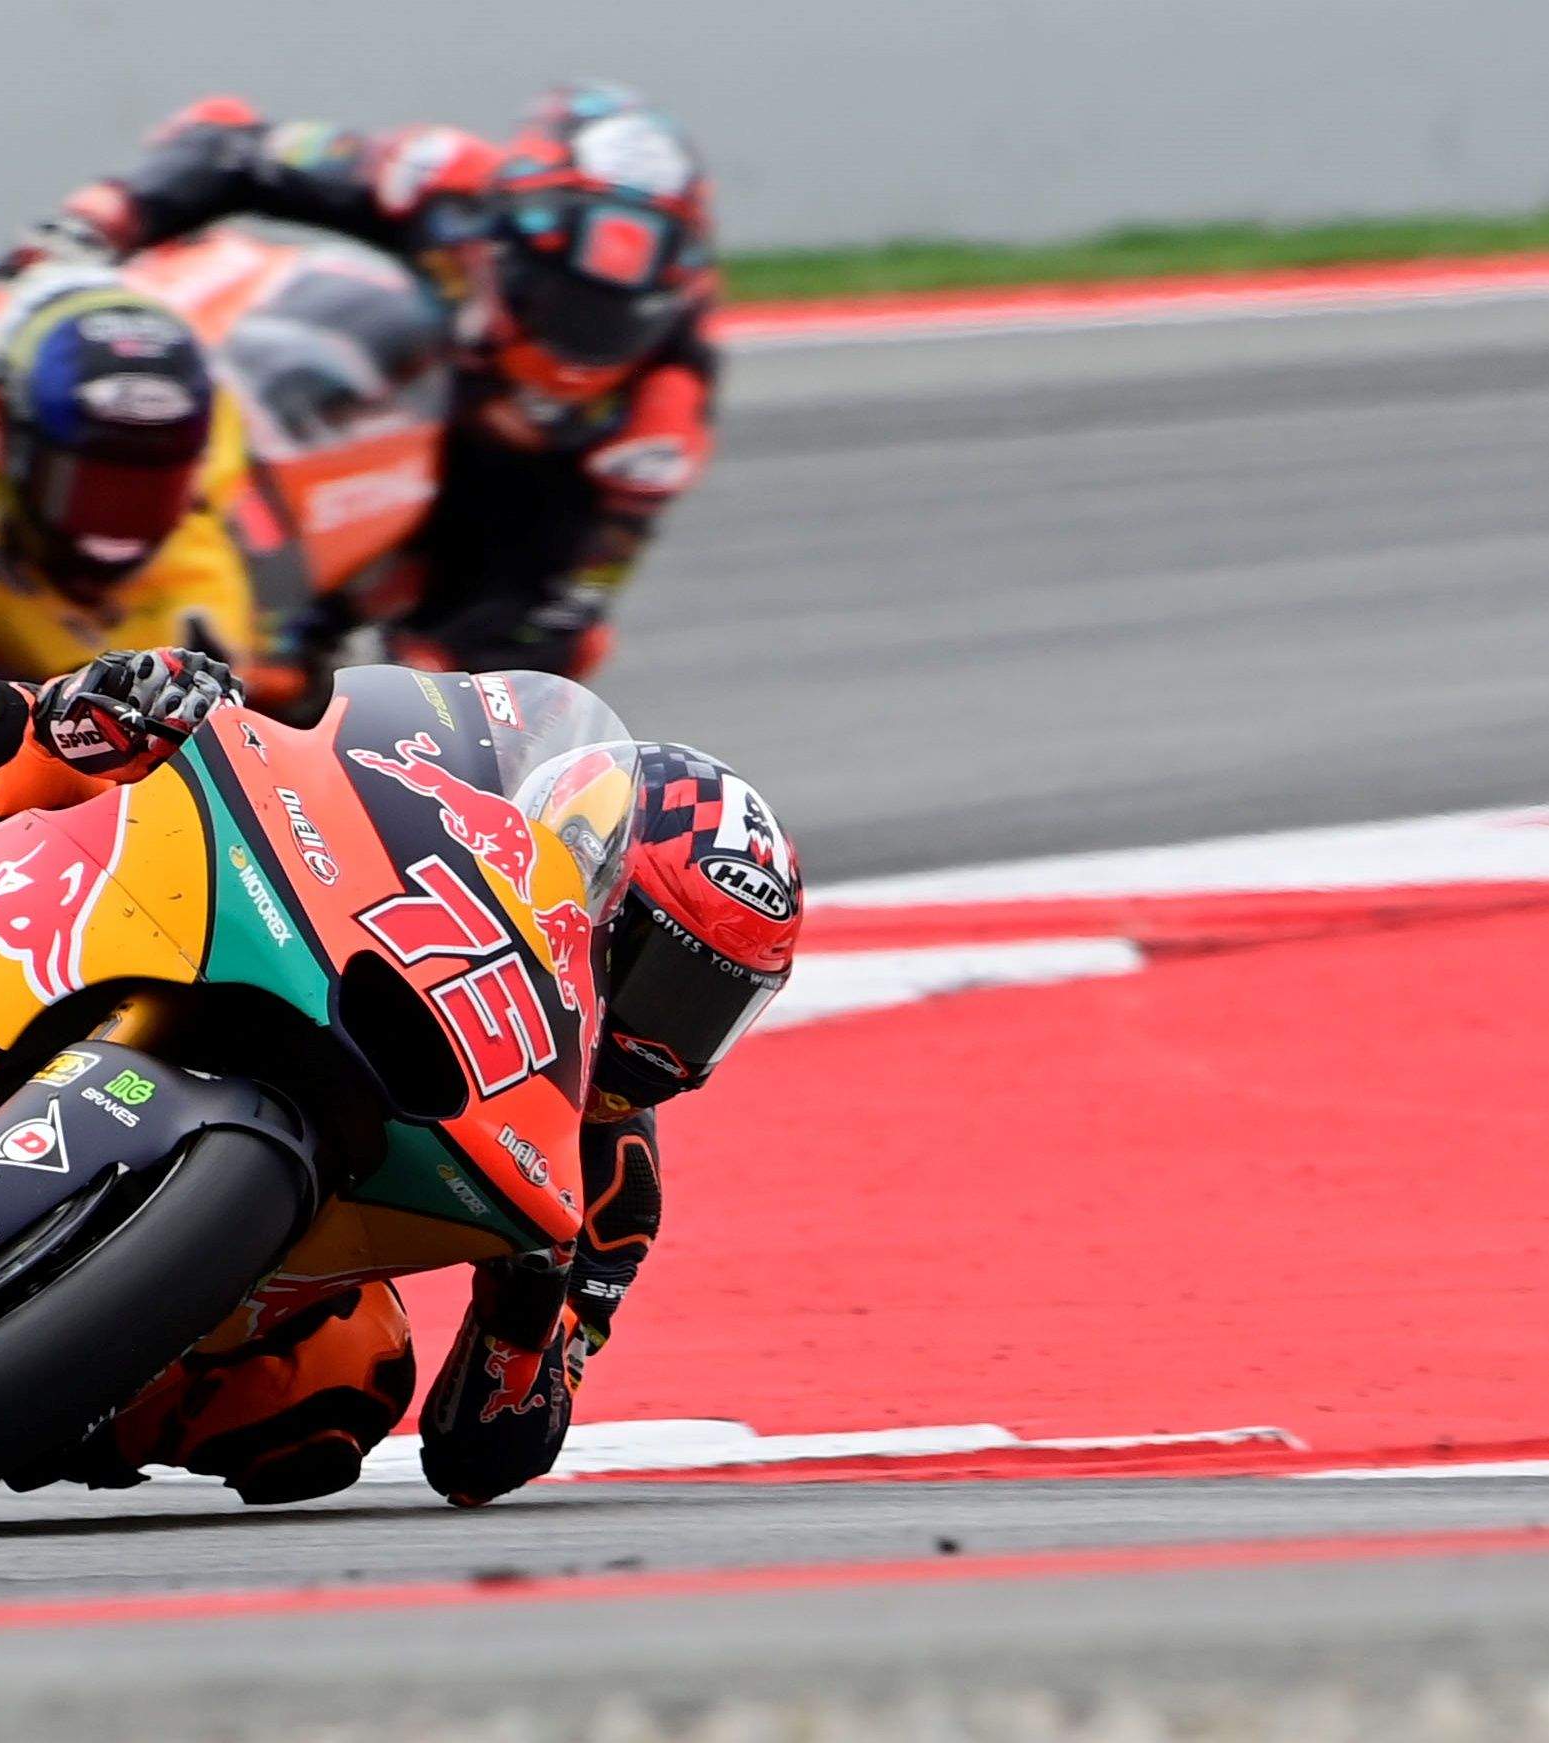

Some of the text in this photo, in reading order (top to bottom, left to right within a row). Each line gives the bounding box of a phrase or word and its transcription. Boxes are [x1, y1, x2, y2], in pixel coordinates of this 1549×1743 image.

[238, 863, 294, 948] MOTOREX
[712, 863, 785, 914] HJC
[358, 854, 558, 1097] 75
[652, 908, 702, 953] GIVES
[708, 952, 744, 978] YOU
[81, 1086, 141, 1128] BRAKES
